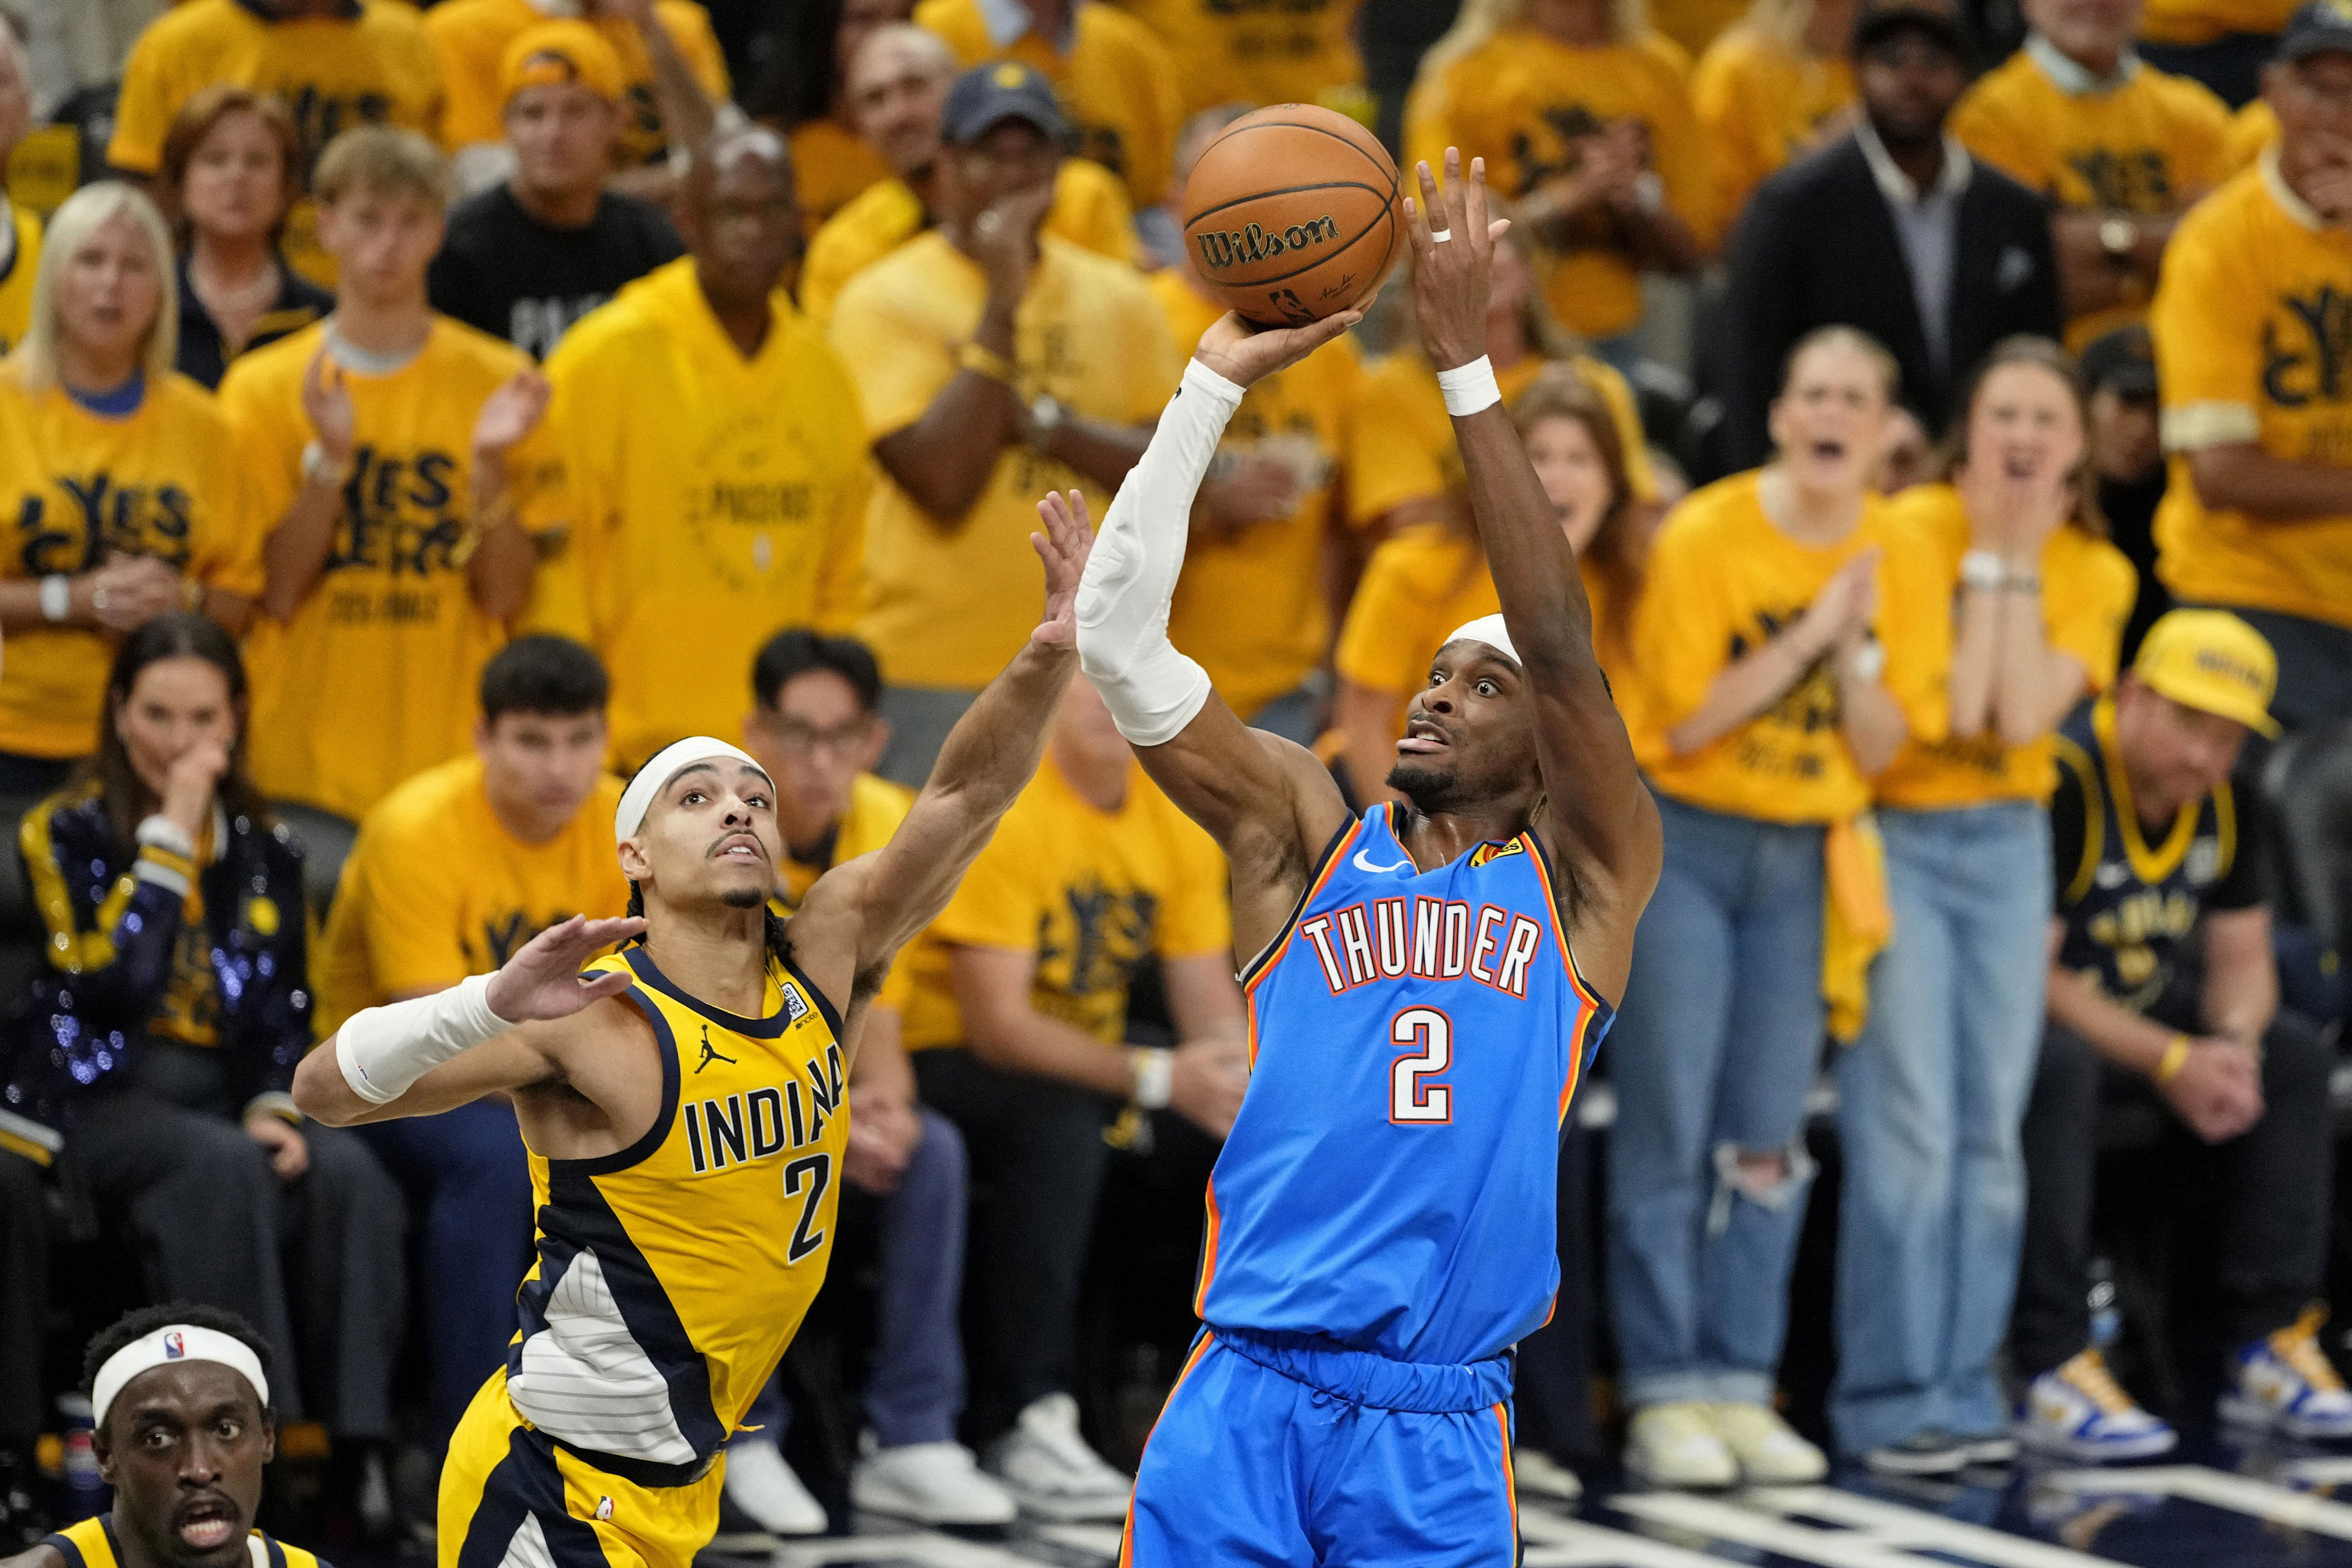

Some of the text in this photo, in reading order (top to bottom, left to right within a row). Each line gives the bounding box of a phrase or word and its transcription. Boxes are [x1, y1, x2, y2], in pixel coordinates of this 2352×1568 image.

[1196, 215, 1340, 269] Wilson
[1298, 895, 1543, 1000] THUNDER
[1390, 1004, 1452, 1124] 2
[784, 1152, 832, 1265] 2
